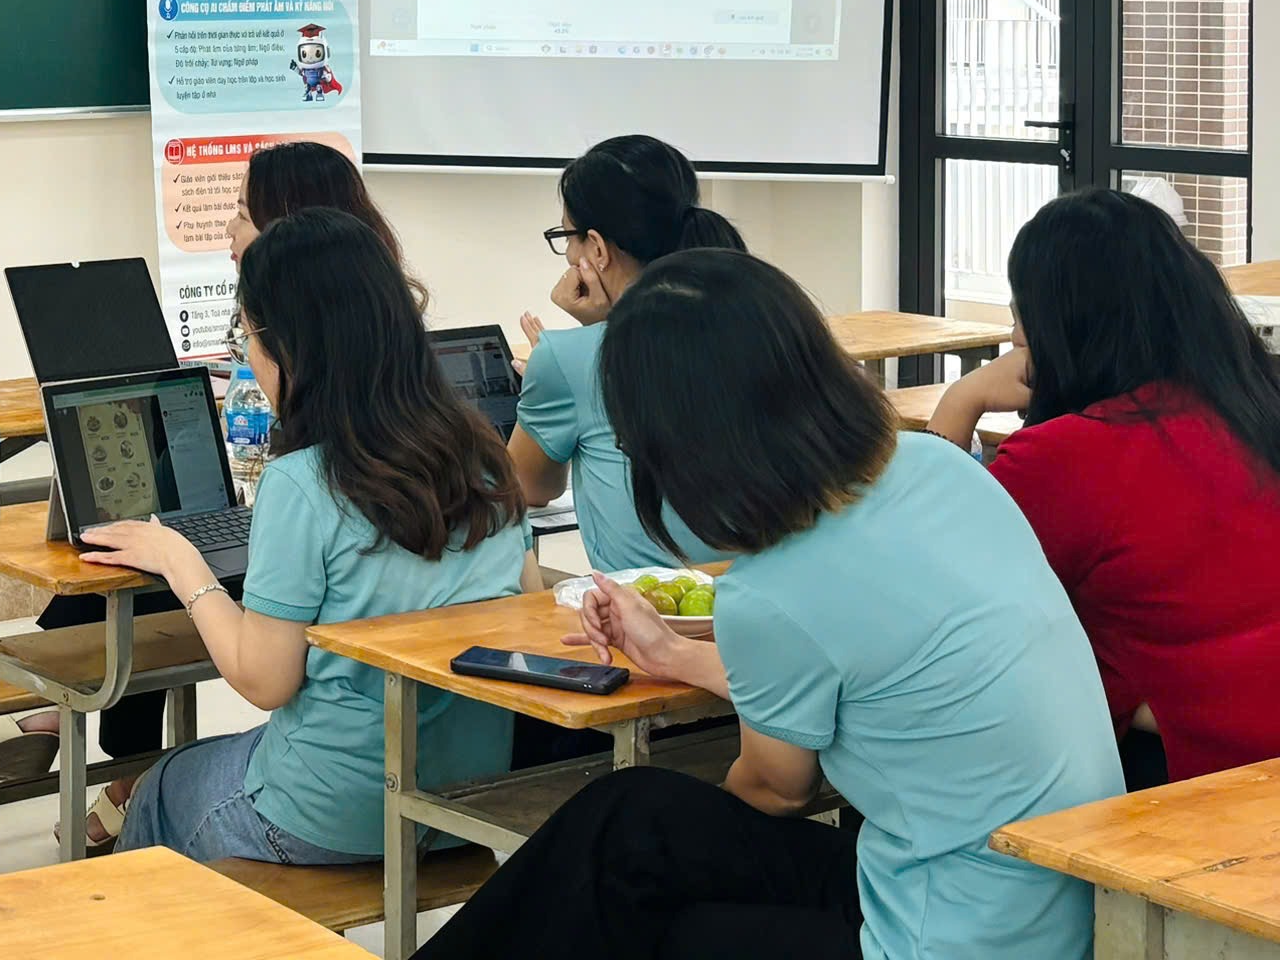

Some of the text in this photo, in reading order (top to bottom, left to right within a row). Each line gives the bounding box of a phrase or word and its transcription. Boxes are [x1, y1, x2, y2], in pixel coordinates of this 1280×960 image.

[186, 146, 197, 158] HỆ
[199, 142, 223, 156] THỐNG
[226, 143, 241, 154] LMS
[243, 143, 253, 153] VÀ
[180, 285, 201, 299] CÔNG
[204, 285, 213, 297] TY
[216, 279, 226, 296] CỔ
